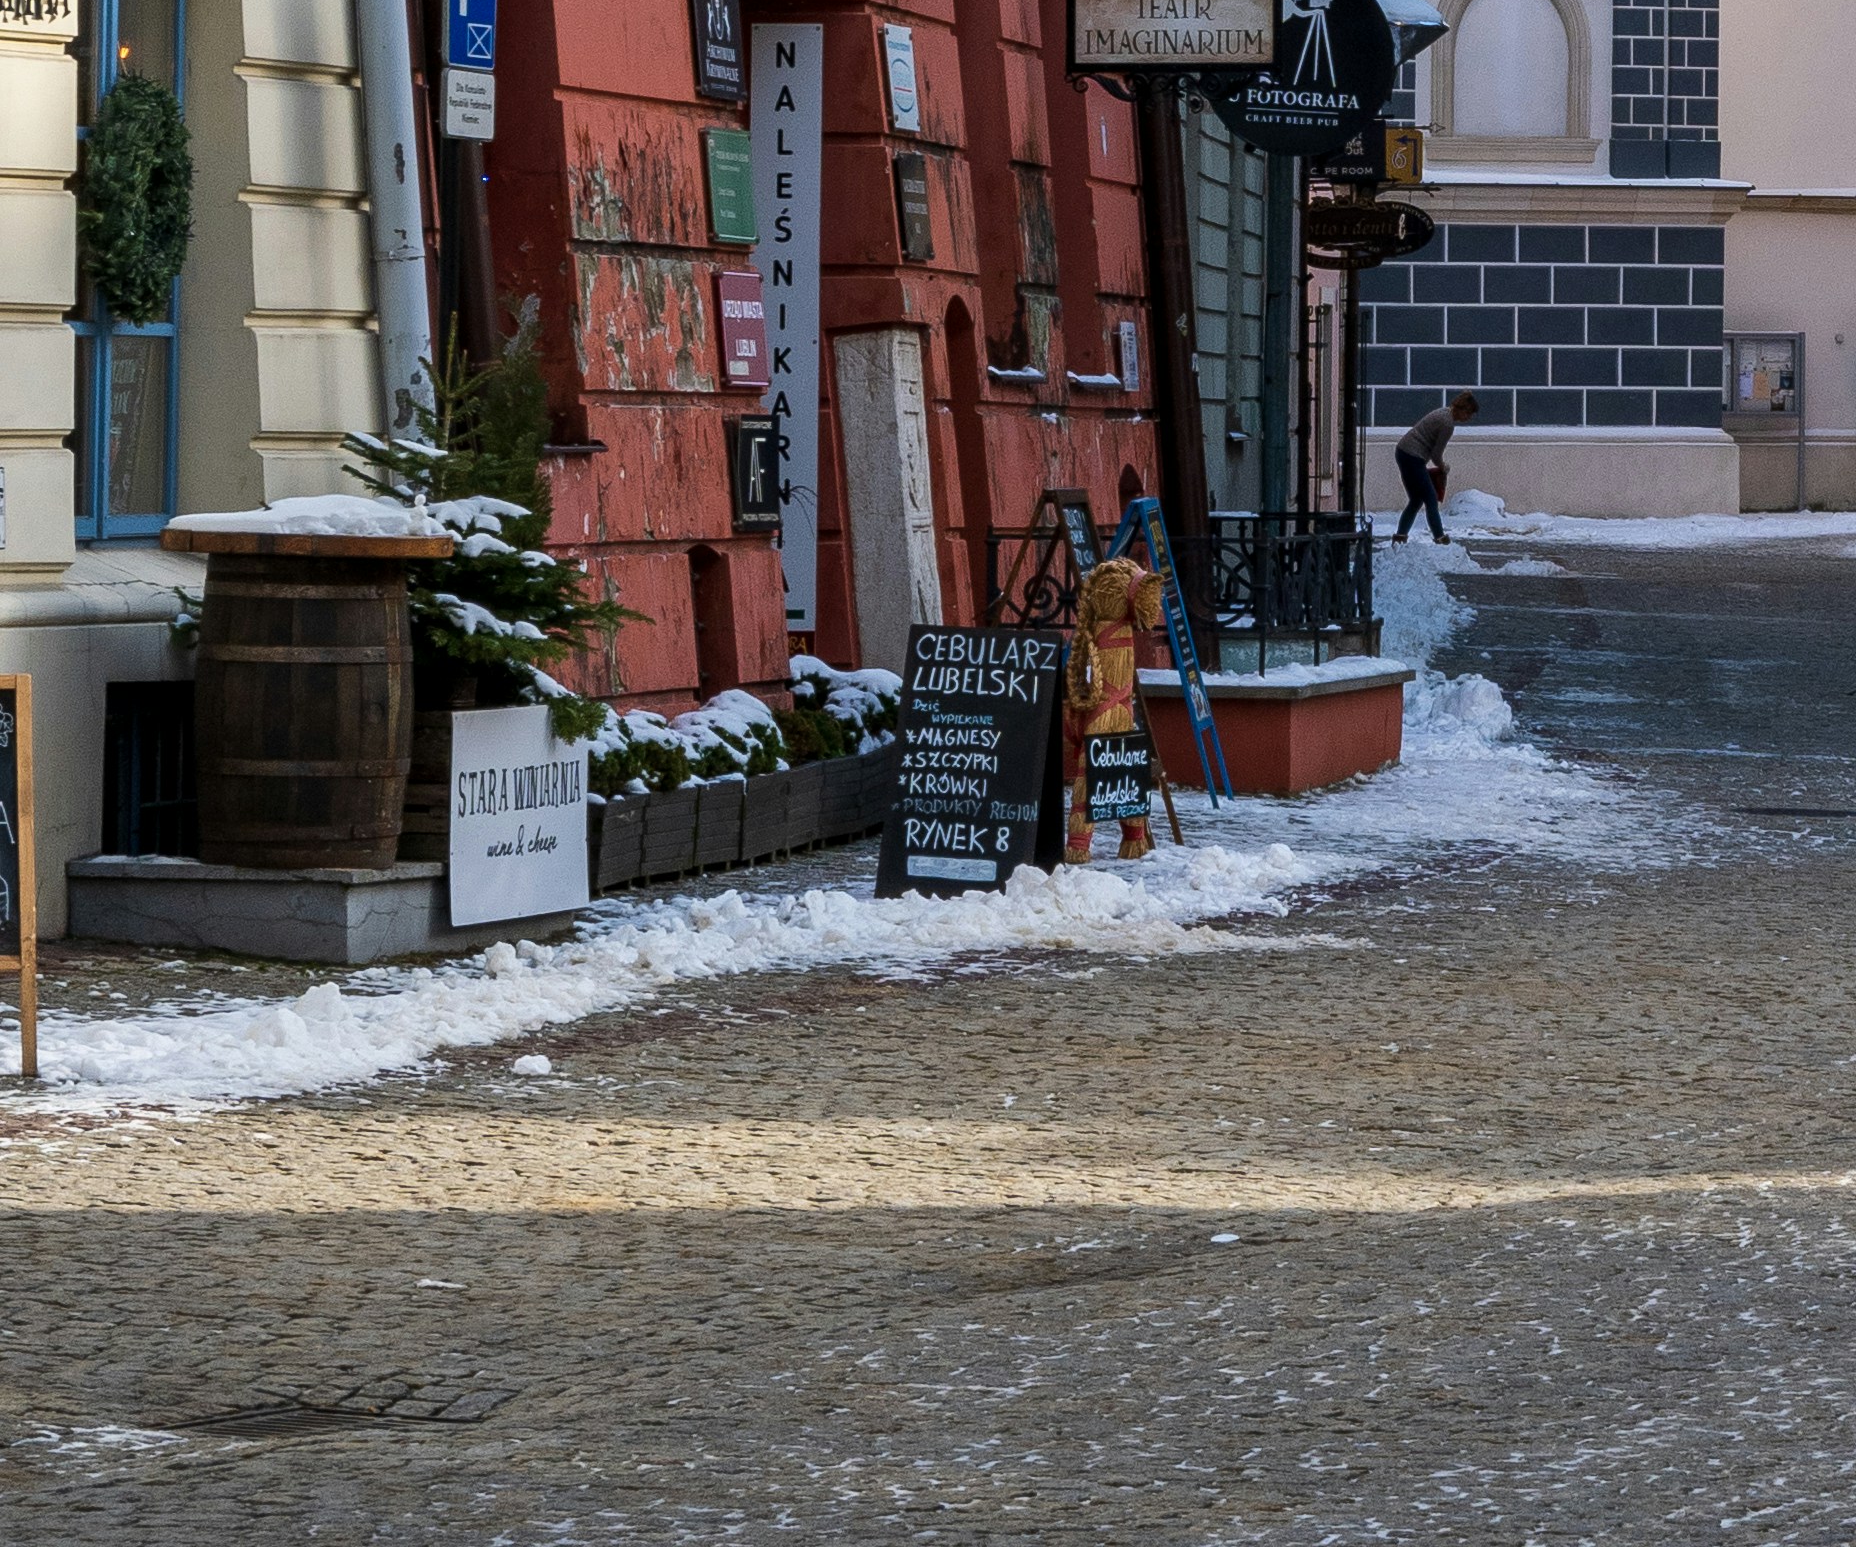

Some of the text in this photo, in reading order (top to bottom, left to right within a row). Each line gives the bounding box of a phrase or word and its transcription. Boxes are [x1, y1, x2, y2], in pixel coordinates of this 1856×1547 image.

[1085, 29, 1265, 56] IMAGINARIUM
[1247, 89, 1360, 109] FOTOGRAFA
[1245, 114, 1339, 127] CRAFT BEER PUB
[1341, 167, 1373, 175] ROOM
[916, 633, 1057, 671] CEBULARZ
[912, 666, 1038, 704] LUBELSKI
[917, 727, 1001, 750] MAGNESY
[458, 760, 581, 818] STARA WINIARNIA
[910, 772, 988, 799] KRÓWKI
[903, 798, 982, 817] PRODUKTY
[487, 841, 513, 857] wine
[528, 825, 558, 854] cheese
[904, 818, 1010, 854] RYNEK 8
